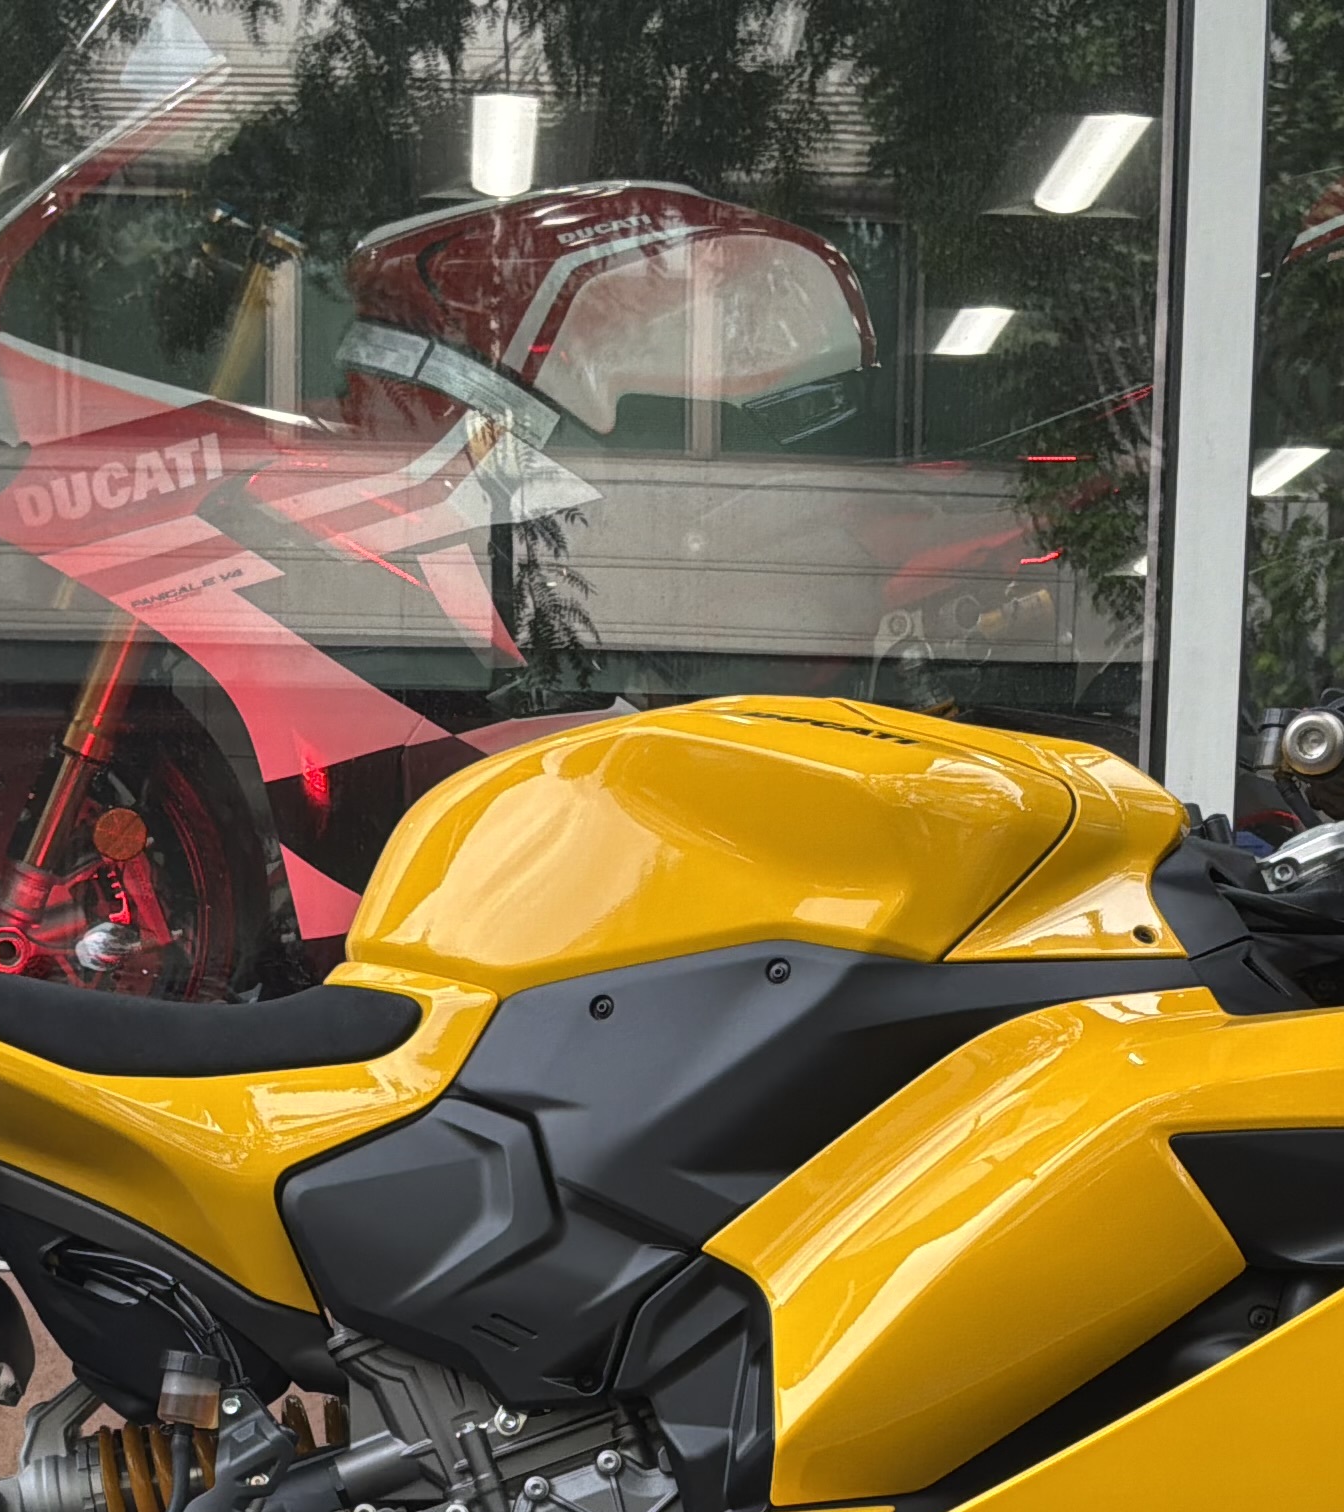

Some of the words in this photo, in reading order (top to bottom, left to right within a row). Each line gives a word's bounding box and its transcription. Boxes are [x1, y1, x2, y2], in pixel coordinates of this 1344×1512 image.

[557, 214, 652, 244] DUCATI
[13, 432, 224, 527] DUCATI
[131, 577, 216, 608] PANIGALE
[741, 711, 922, 745] DUCATI
